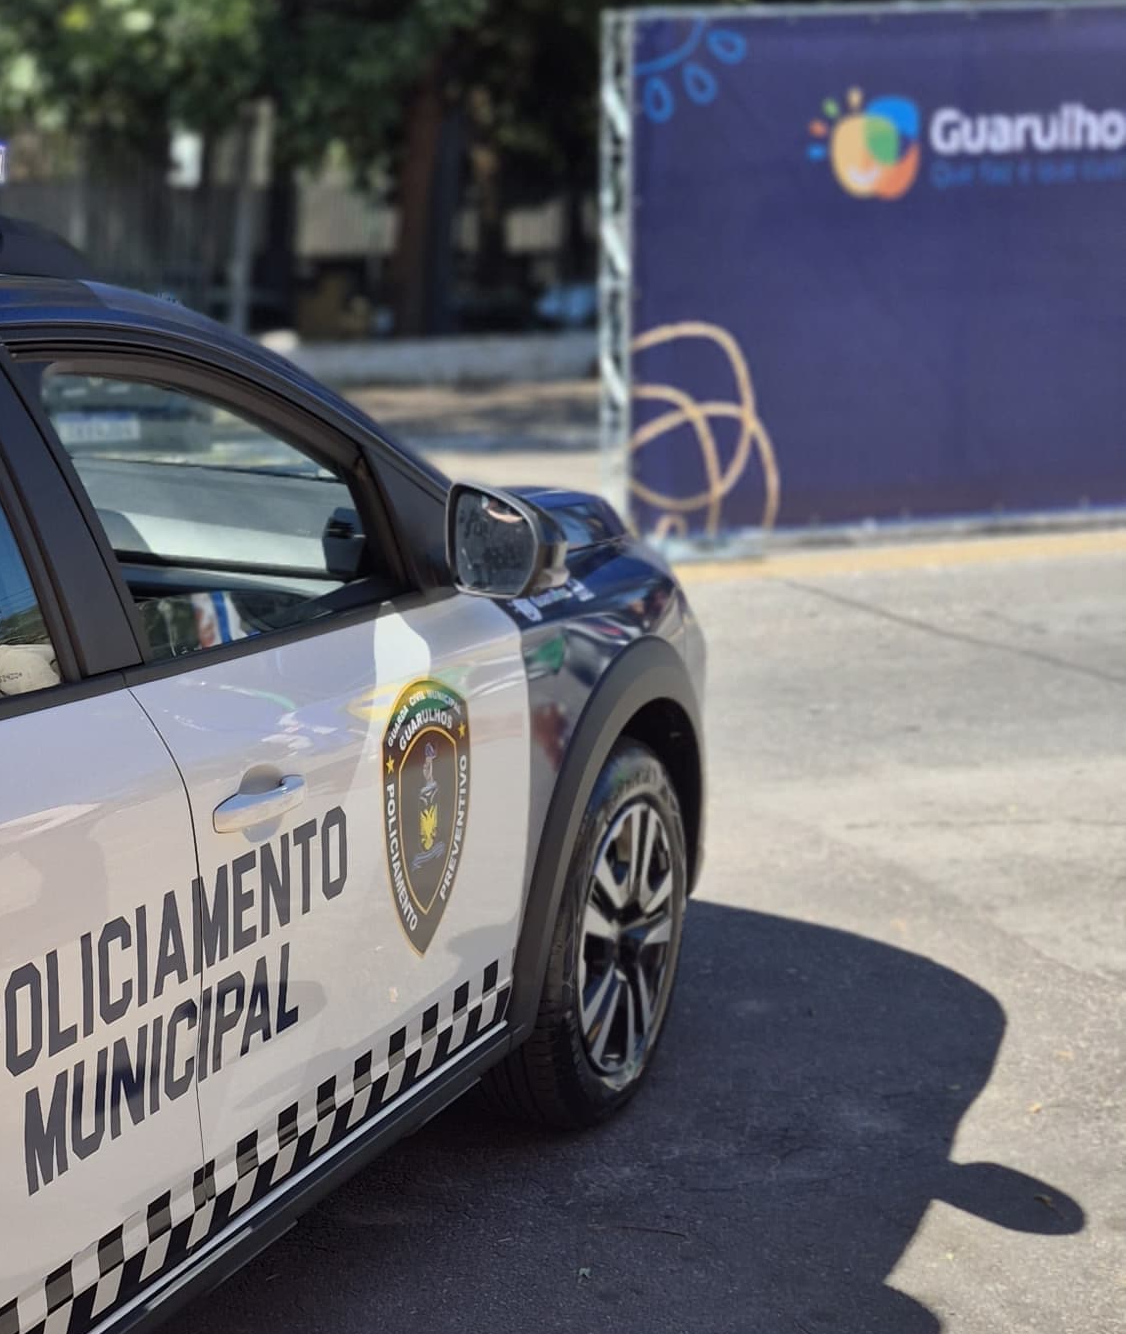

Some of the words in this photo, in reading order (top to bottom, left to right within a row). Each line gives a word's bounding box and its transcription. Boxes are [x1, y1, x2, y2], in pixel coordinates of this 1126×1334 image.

[388, 705, 409, 748] GUARDA
[409, 690, 426, 706] CIVIL
[399, 707, 453, 751] GUARULHOS
[386, 782, 419, 931] POLICIAMENTO
[439, 754, 467, 902] PREVENTIVO
[24, 942, 299, 1197] MUNICIPAL
